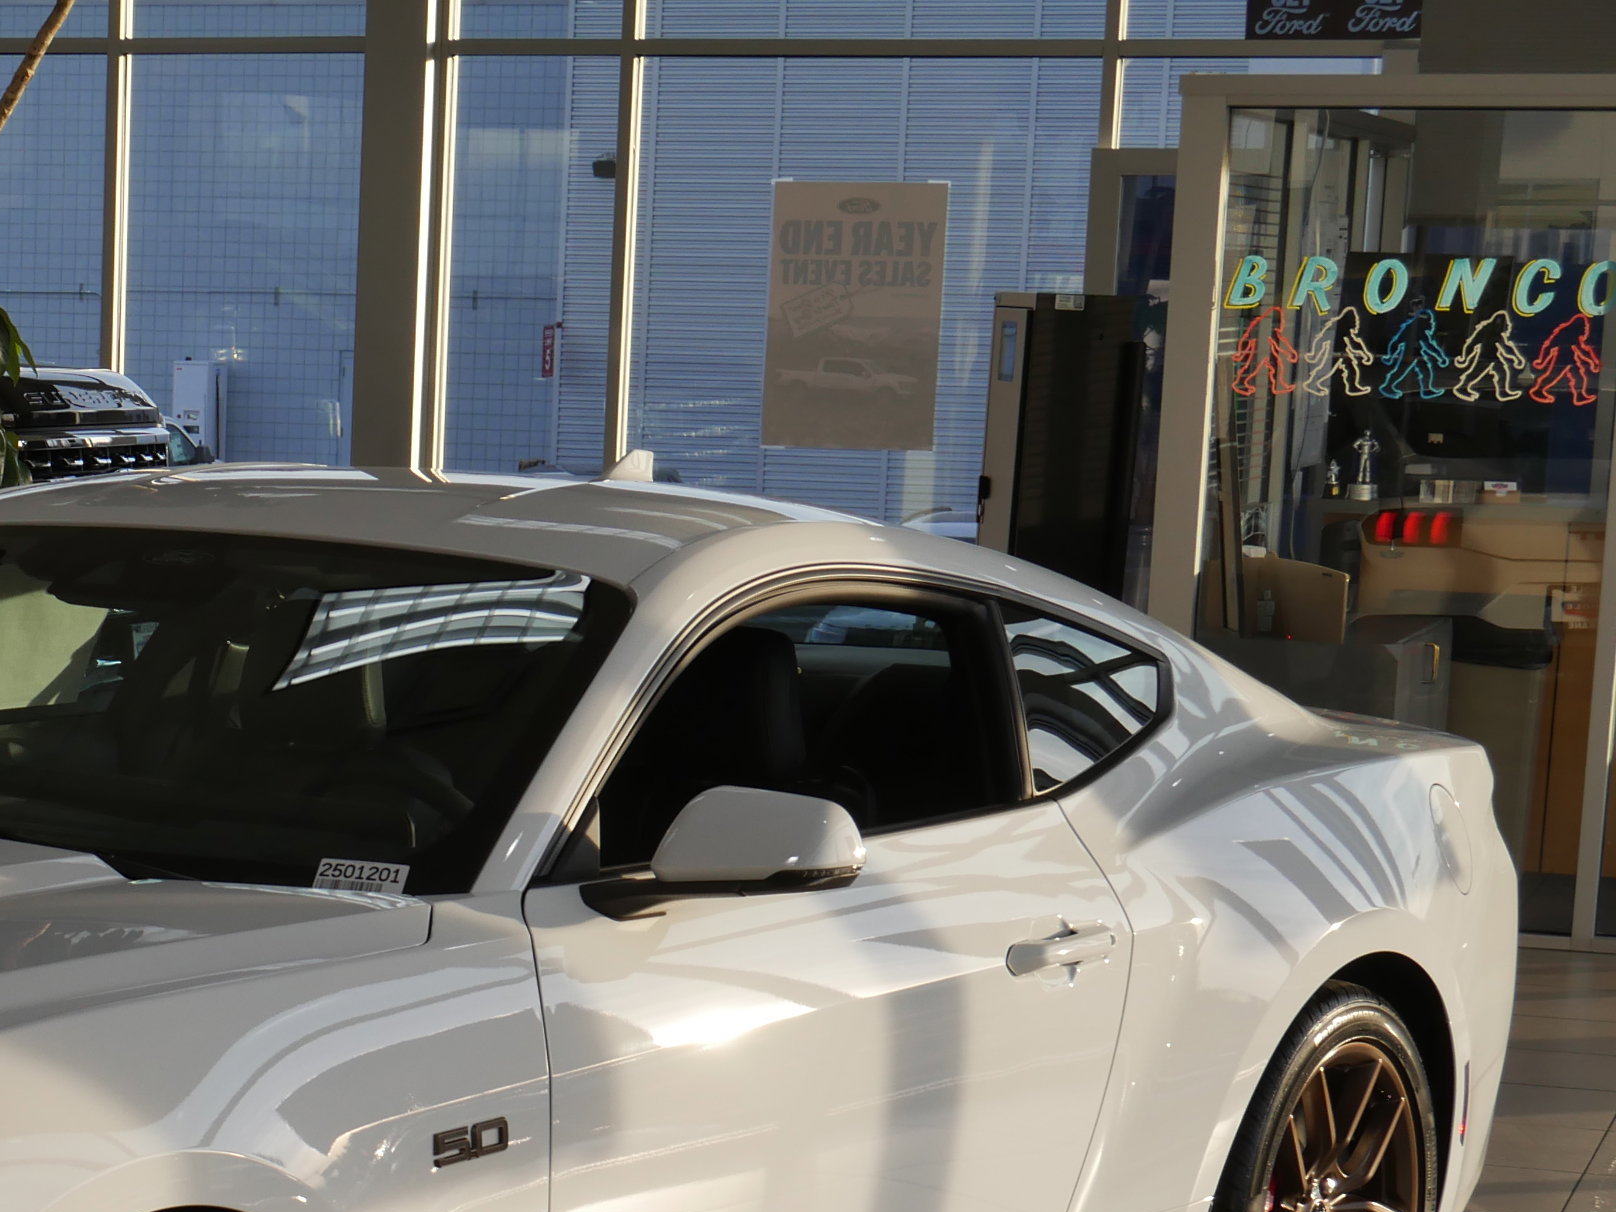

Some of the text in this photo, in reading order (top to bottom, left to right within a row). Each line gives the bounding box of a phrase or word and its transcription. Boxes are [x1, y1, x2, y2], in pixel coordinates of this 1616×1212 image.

[1255, 7, 1325, 35] Ford
[1348, 4, 1419, 32] Ford
[1224, 255, 1616, 317] BRONCO
[318, 862, 401, 884] 2501201
